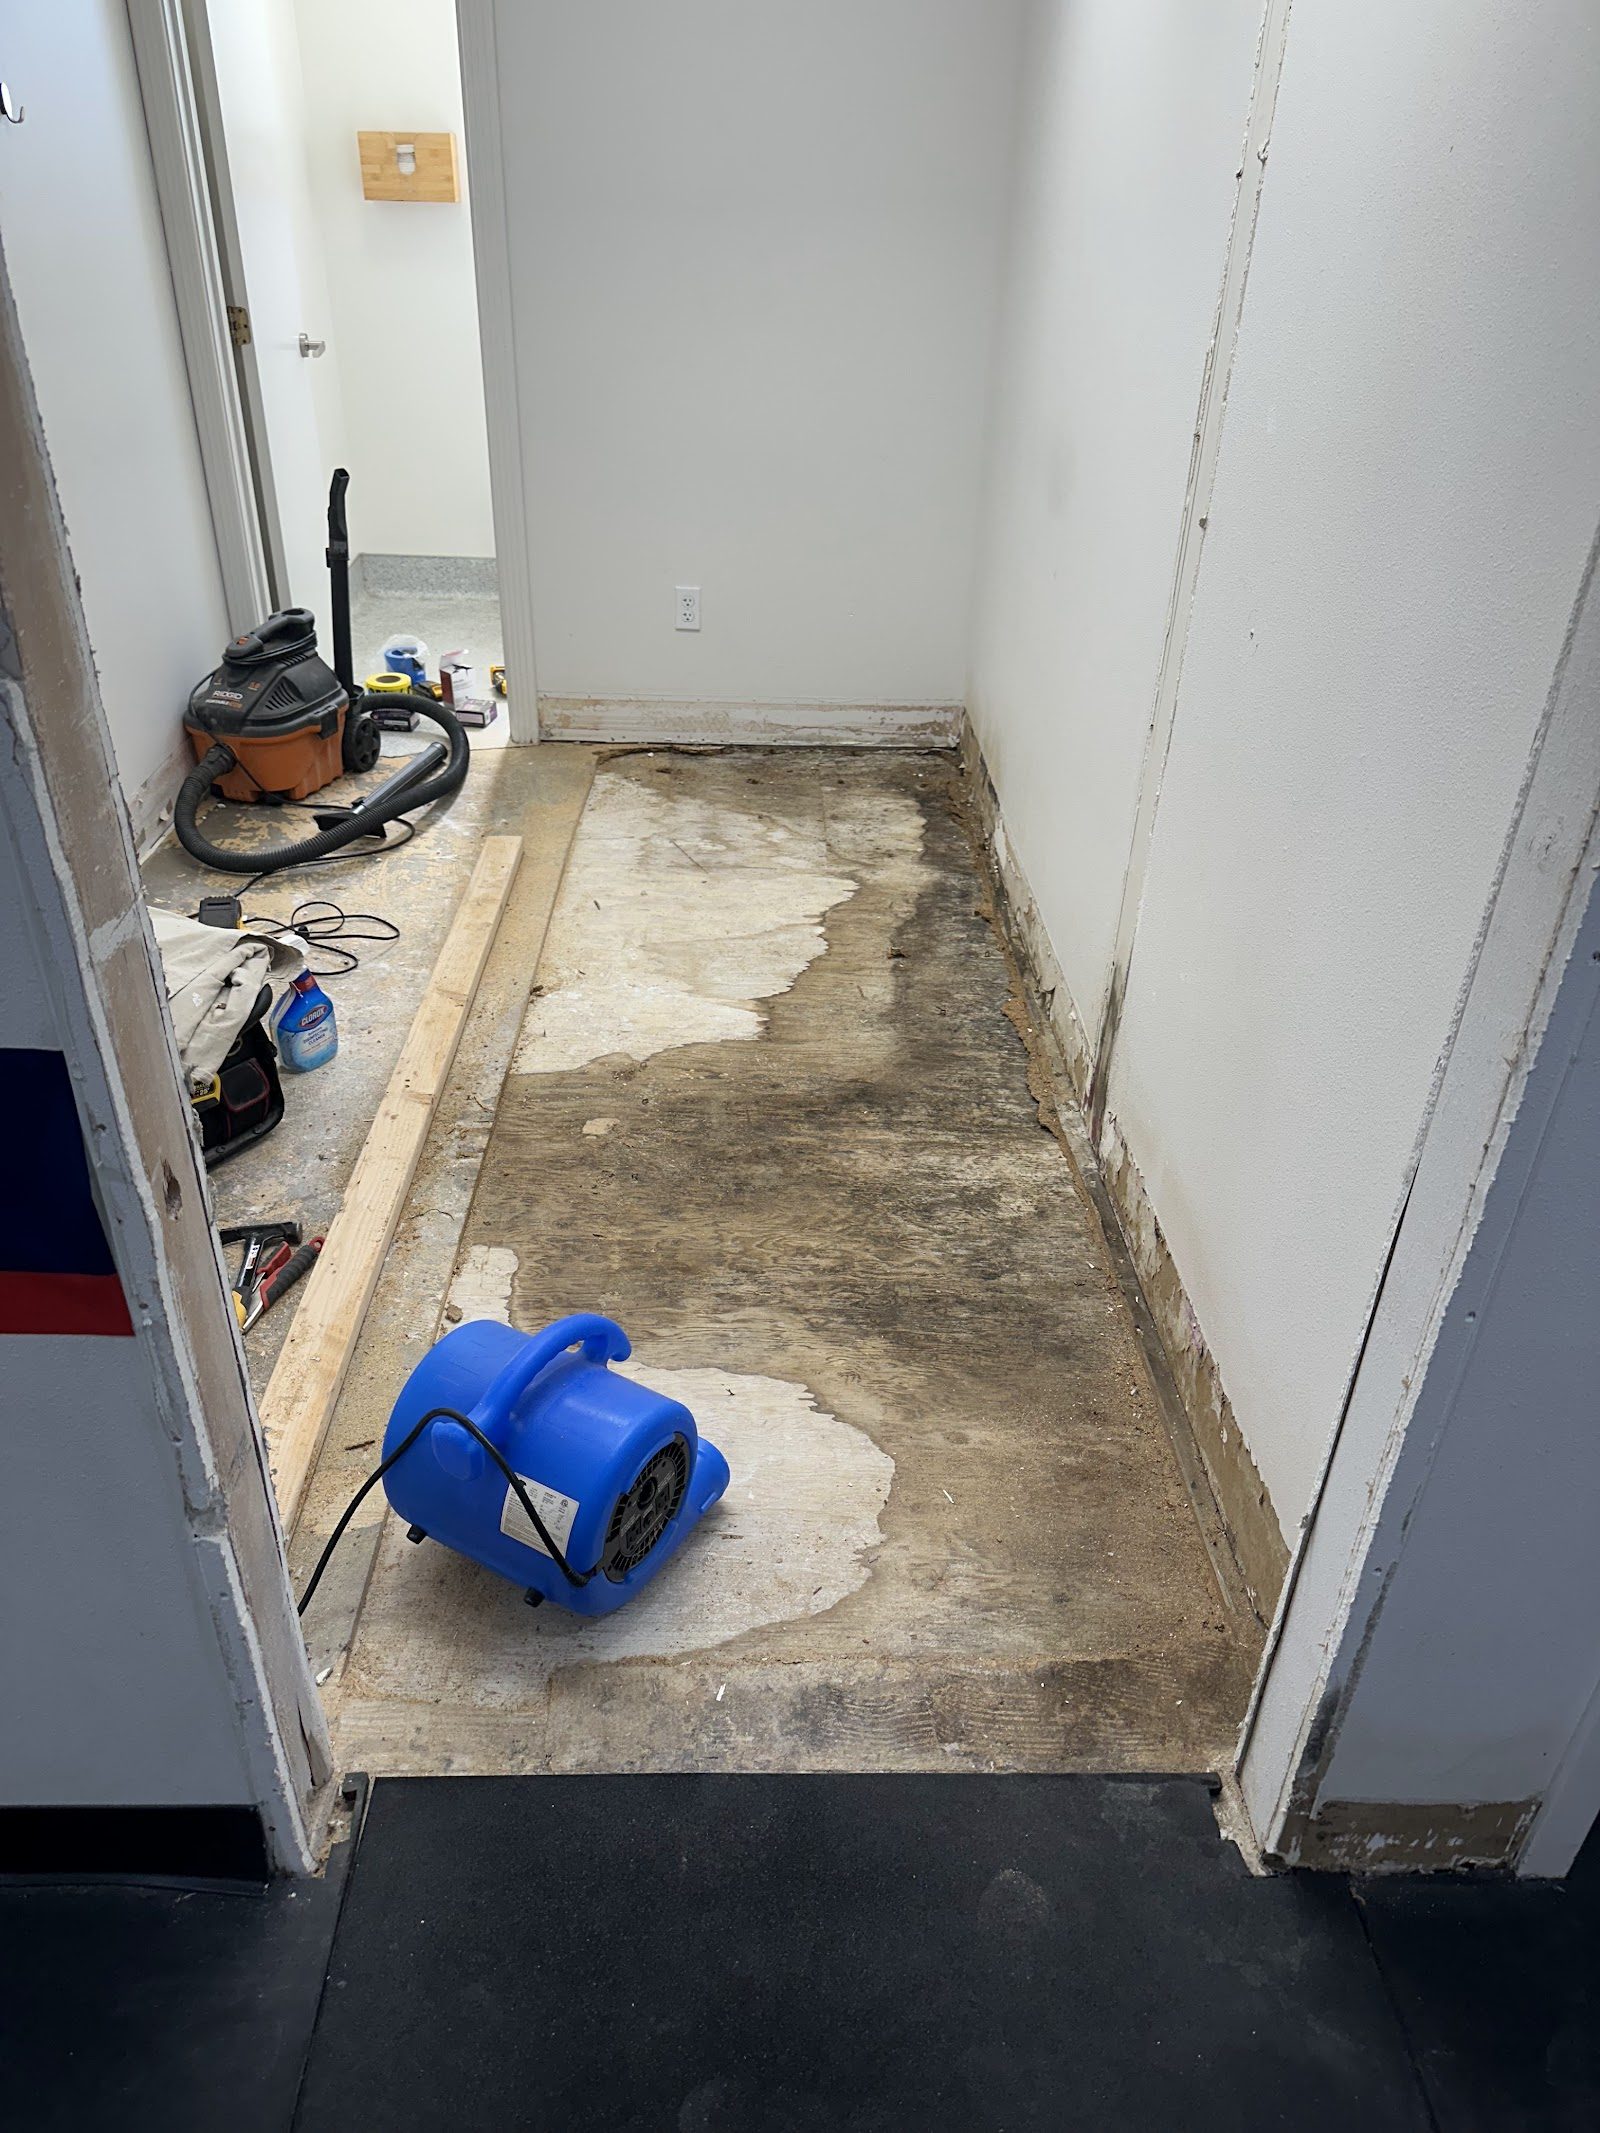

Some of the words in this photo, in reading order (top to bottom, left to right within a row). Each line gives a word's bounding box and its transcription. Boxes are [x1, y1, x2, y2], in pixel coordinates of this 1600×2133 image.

[213, 690, 243, 700] RIDGID
[301, 1007, 325, 1026] CLOROX
[308, 1033, 325, 1045] CLEANER
